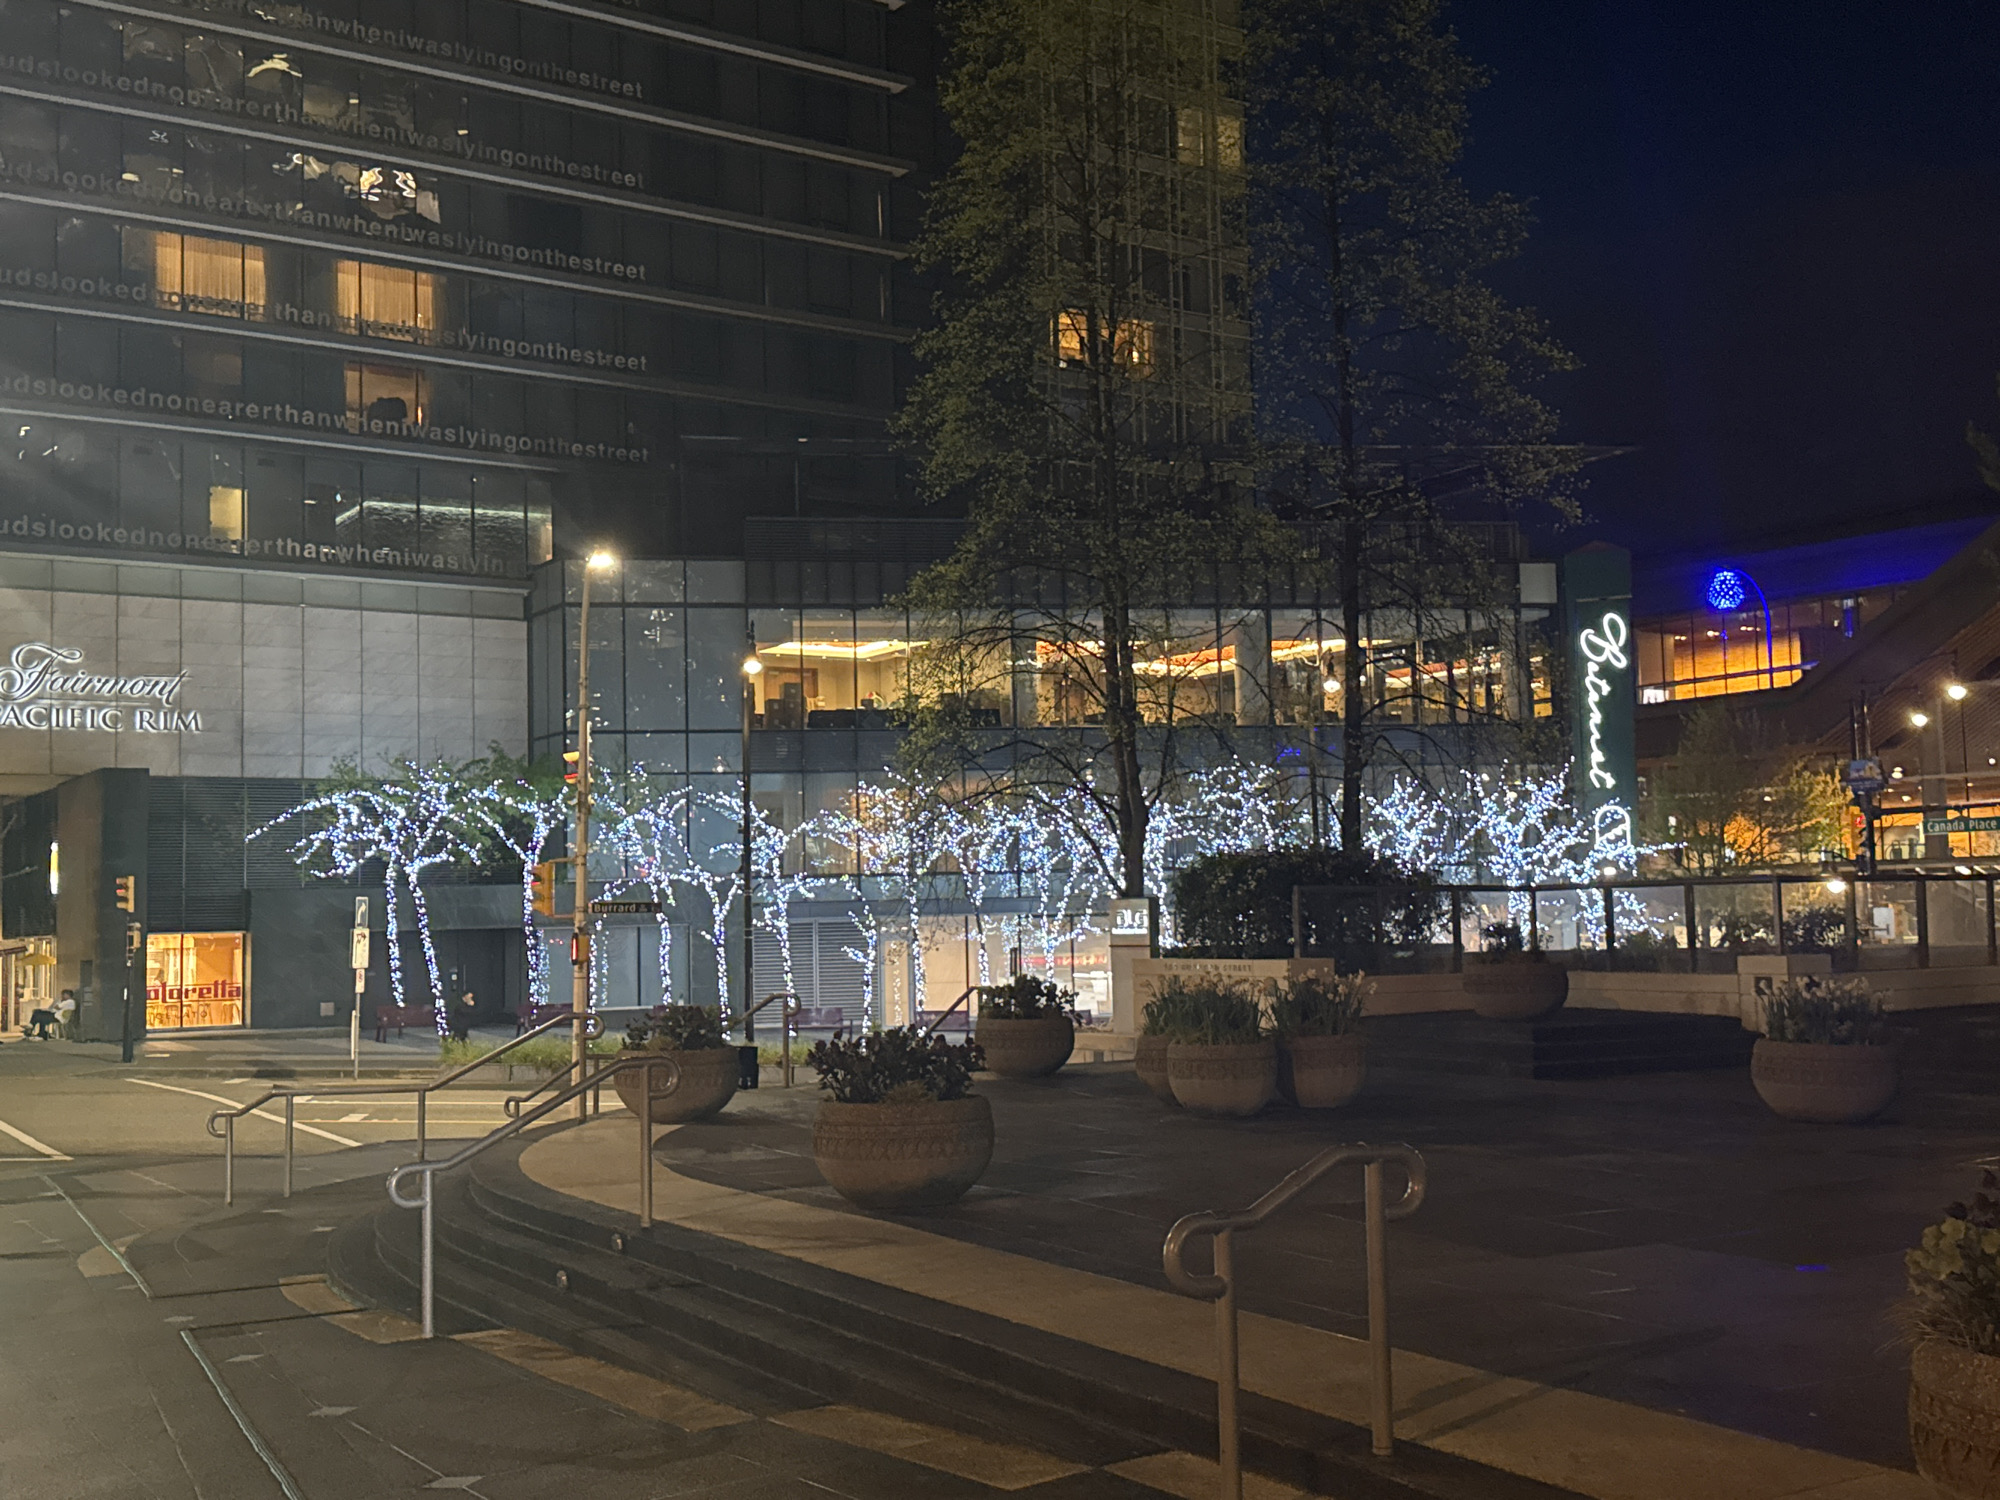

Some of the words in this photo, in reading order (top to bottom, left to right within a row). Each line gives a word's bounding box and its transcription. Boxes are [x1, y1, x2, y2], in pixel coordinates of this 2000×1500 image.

[0, 641, 194, 708] Fairmont
[0, 703, 125, 731] ACIFIC
[135, 708, 202, 733] RIM
[1927, 821, 1965, 833] Canada
[1968, 819, 1998, 831] Place
[594, 903, 636, 913] Burrard
